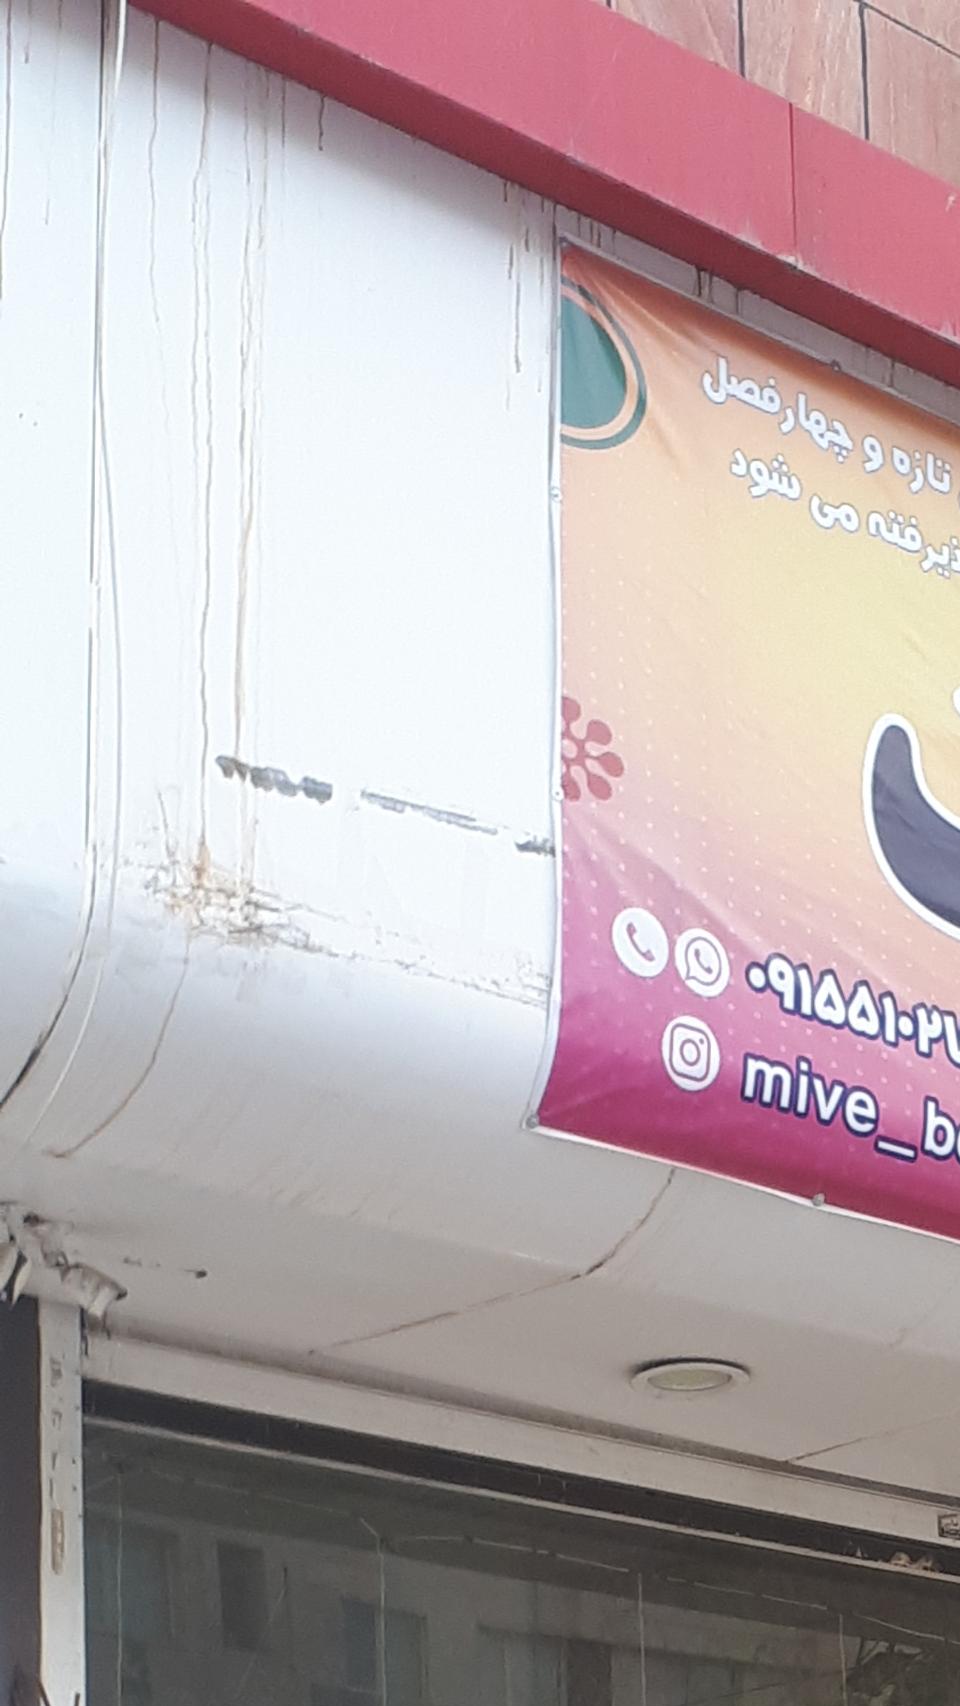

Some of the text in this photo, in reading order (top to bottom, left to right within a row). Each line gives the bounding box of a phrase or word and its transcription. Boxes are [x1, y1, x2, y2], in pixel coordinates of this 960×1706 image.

[730, 448, 802, 501] شود
[862, 434, 885, 473] و
[893, 447, 951, 496] تازه
[811, 495, 860, 534] می
